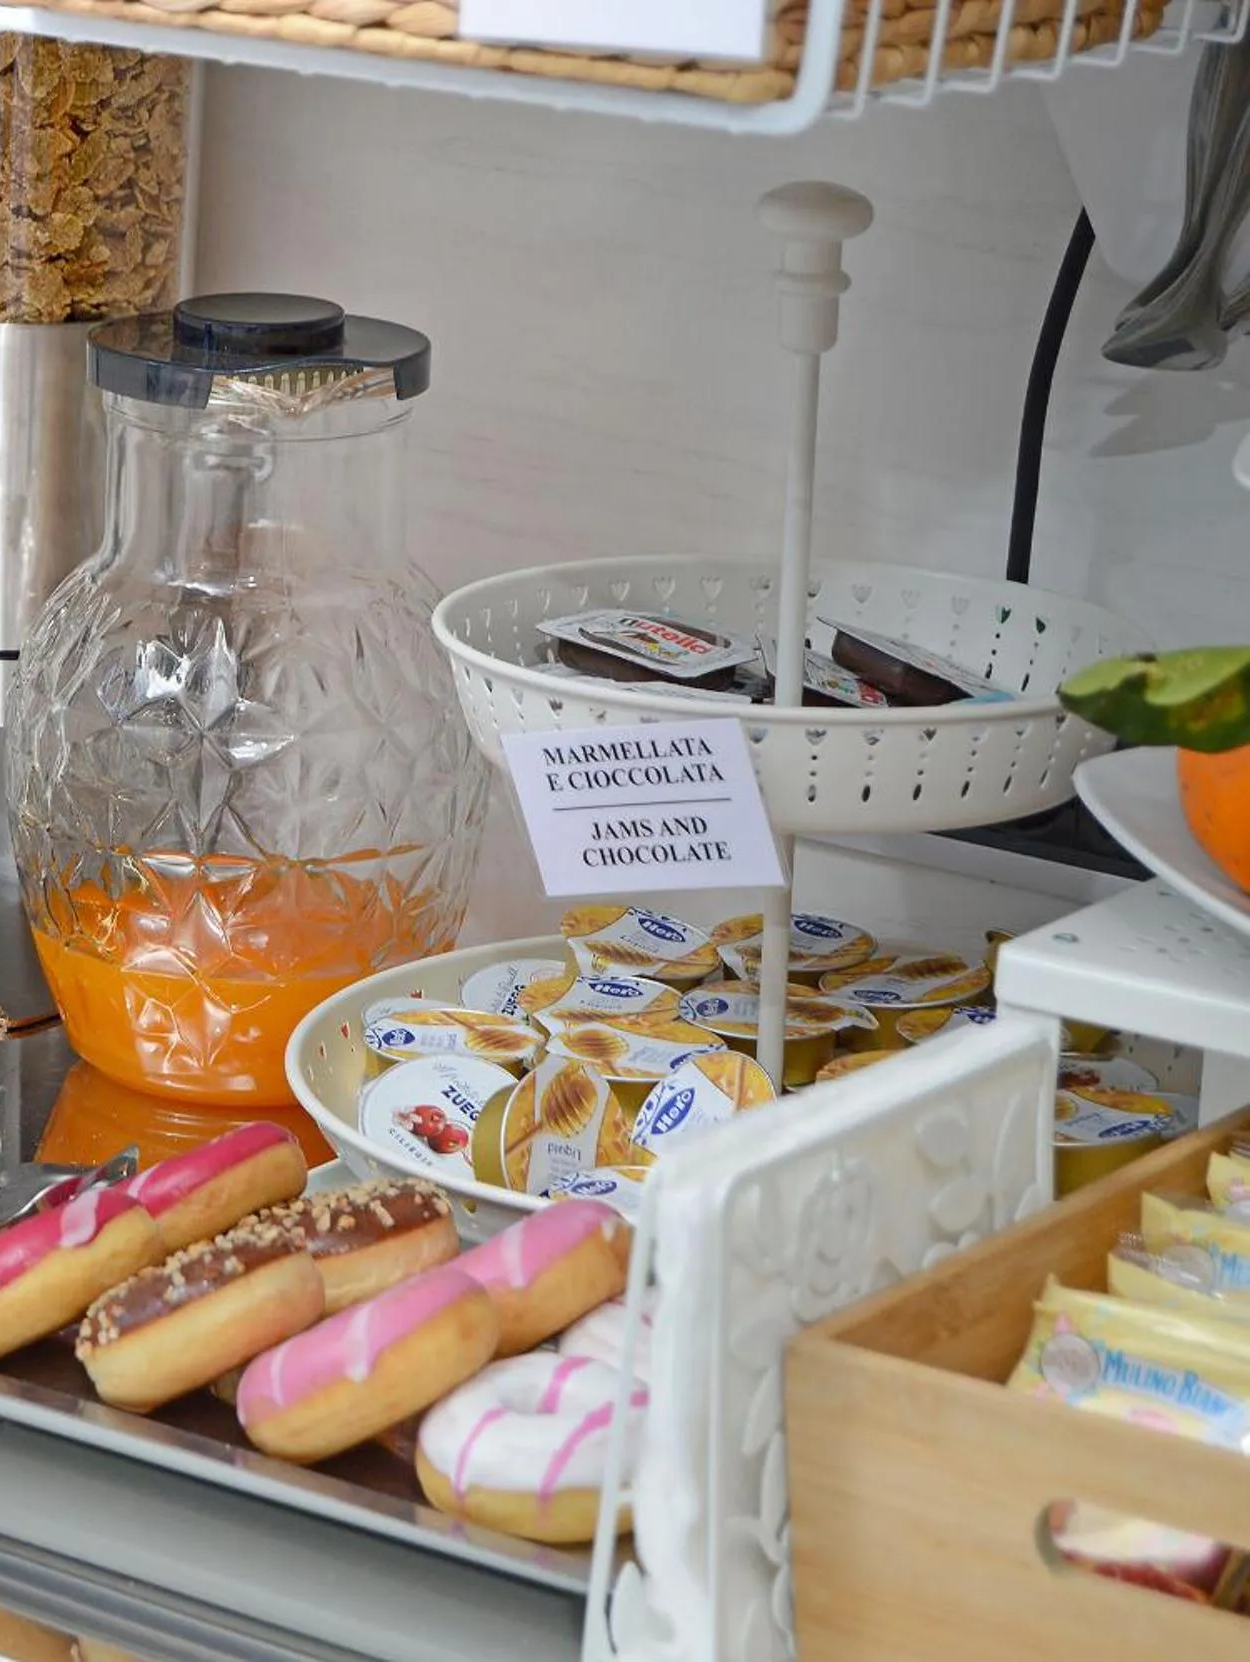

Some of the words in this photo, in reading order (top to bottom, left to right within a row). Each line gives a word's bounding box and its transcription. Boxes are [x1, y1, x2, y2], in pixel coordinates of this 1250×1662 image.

[619, 617, 713, 654] nutella
[542, 735, 713, 765] MARMELLATA
[546, 773, 563, 791] E
[567, 763, 725, 791] CIOCCOLATA
[591, 819, 653, 841] JAMS
[658, 816, 708, 838] AND
[582, 841, 732, 867] CHOCOLATE
[642, 919, 683, 942] Hero
[593, 983, 640, 997] Hero
[441, 1085, 480, 1121] ZUEG
[655, 1090, 692, 1133] Hero
